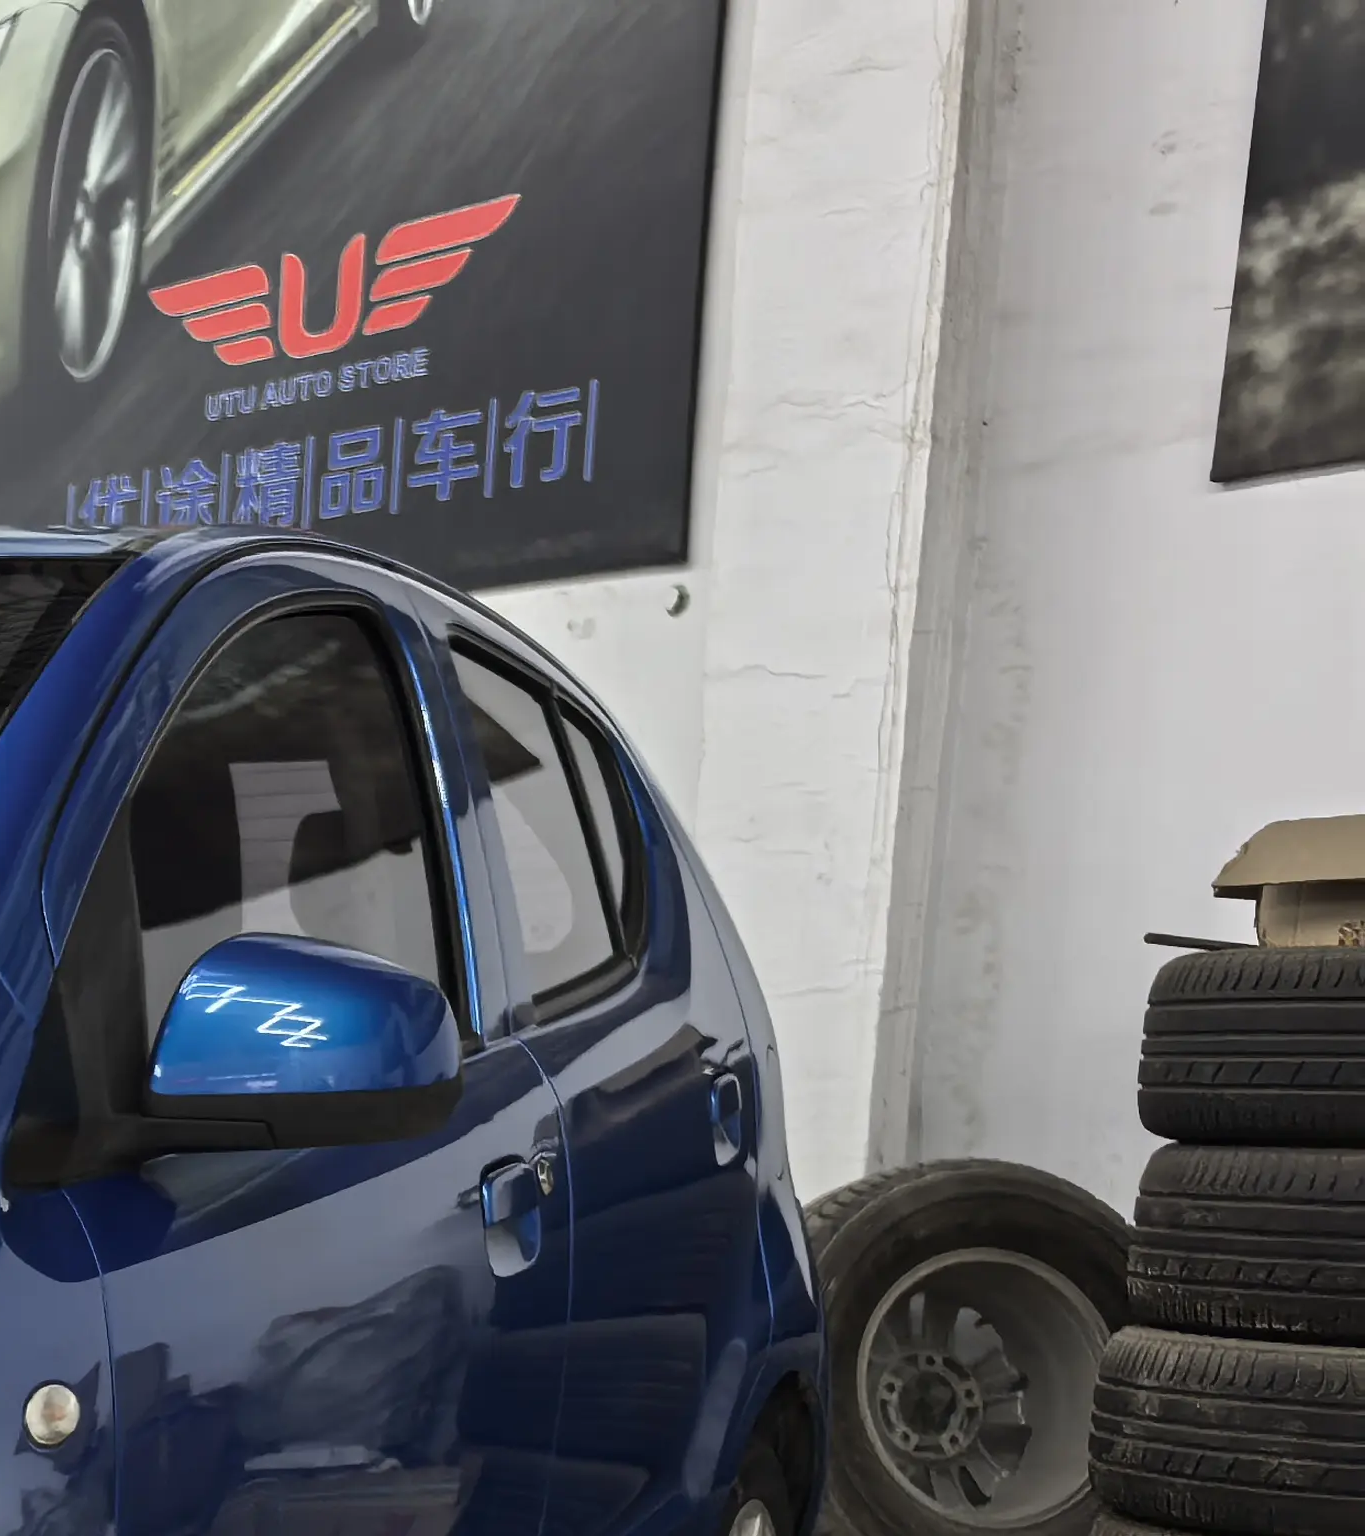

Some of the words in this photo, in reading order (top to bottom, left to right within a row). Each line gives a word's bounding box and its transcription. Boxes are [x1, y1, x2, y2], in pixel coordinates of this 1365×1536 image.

[204, 386, 258, 422] UTU
[260, 370, 332, 411] AUTO
[338, 347, 431, 394] STORE
